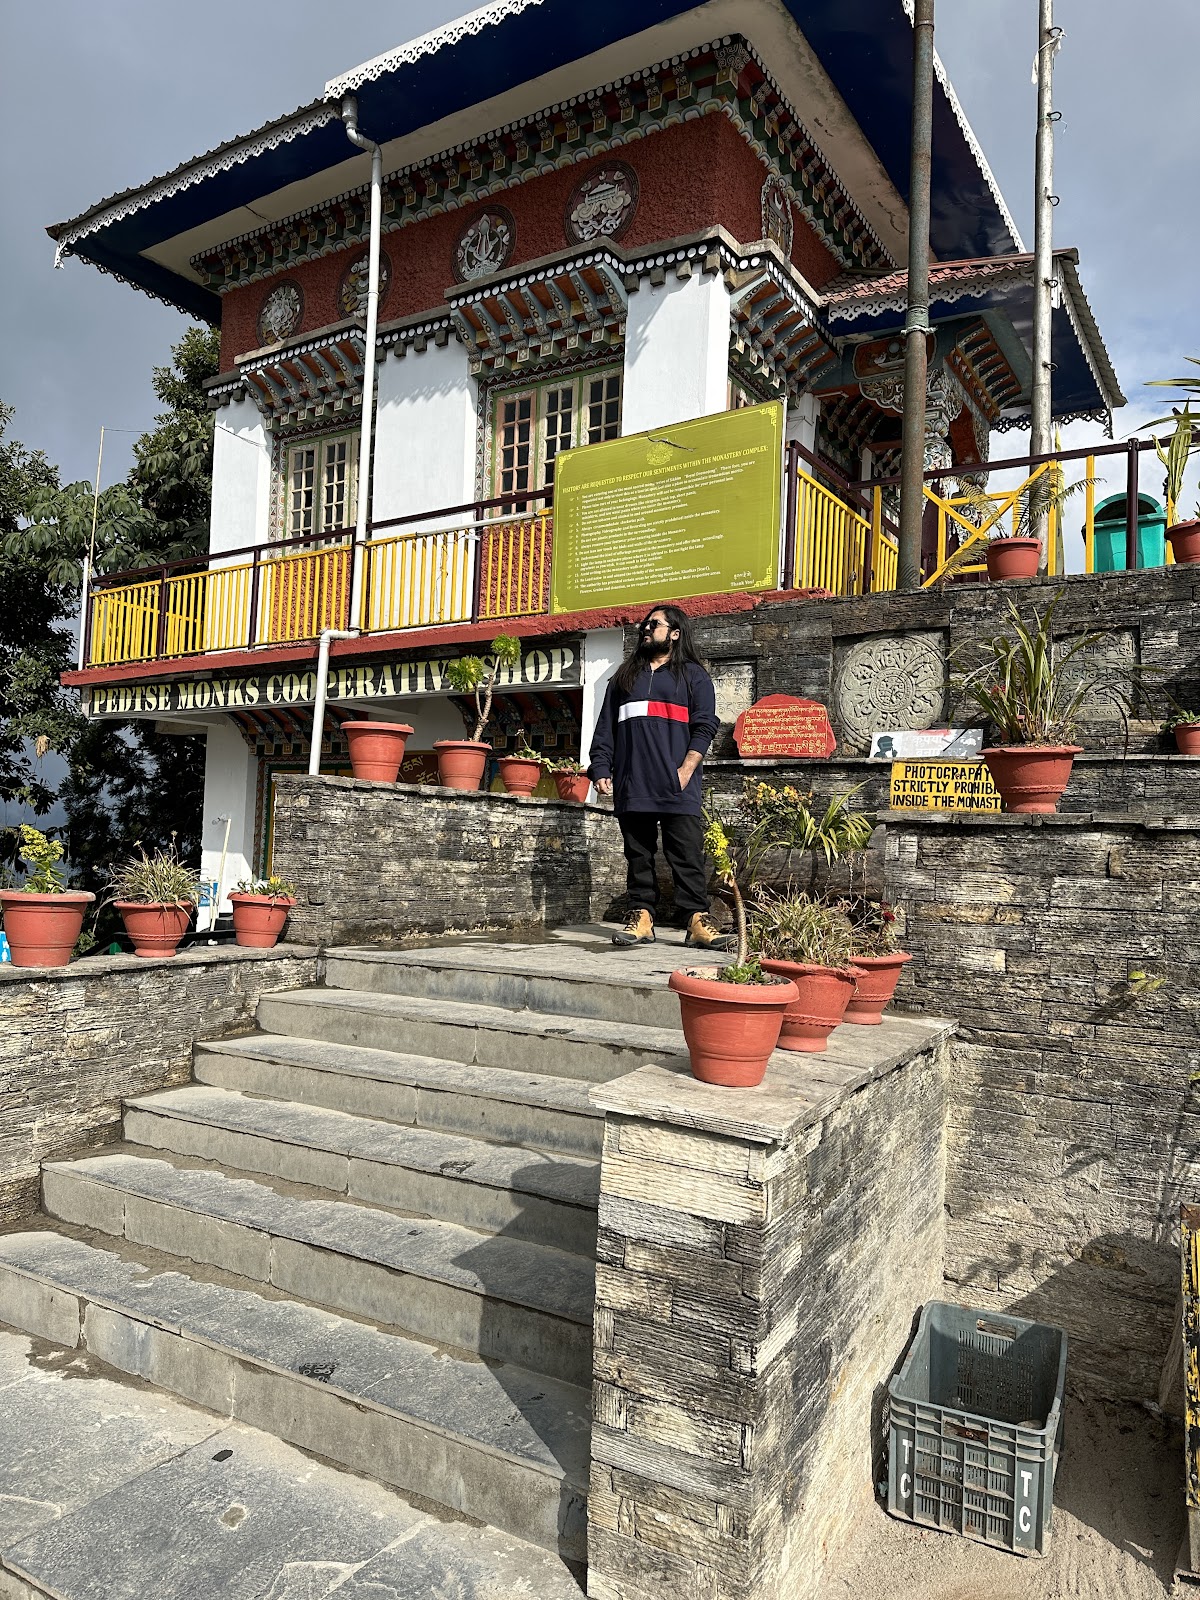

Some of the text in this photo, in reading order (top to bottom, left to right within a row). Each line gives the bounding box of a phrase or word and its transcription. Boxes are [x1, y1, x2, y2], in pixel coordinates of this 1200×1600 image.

[590, 478, 615, 489] REQUESTED
[623, 473, 642, 482] RESPECT
[654, 464, 682, 475] SENTIMENTS
[683, 460, 701, 469] WITHIN
[712, 451, 742, 463] MONASTERY
[743, 445, 769, 456] COMPLEX:
[92, 648, 574, 714] PEDTSE MONKS COOPERATIV SHOP
[905, 766, 990, 781] PHOTOGRAPHY
[894, 780, 949, 793] STRICTLY
[892, 795, 1002, 809] INSIDE THE MONAST
